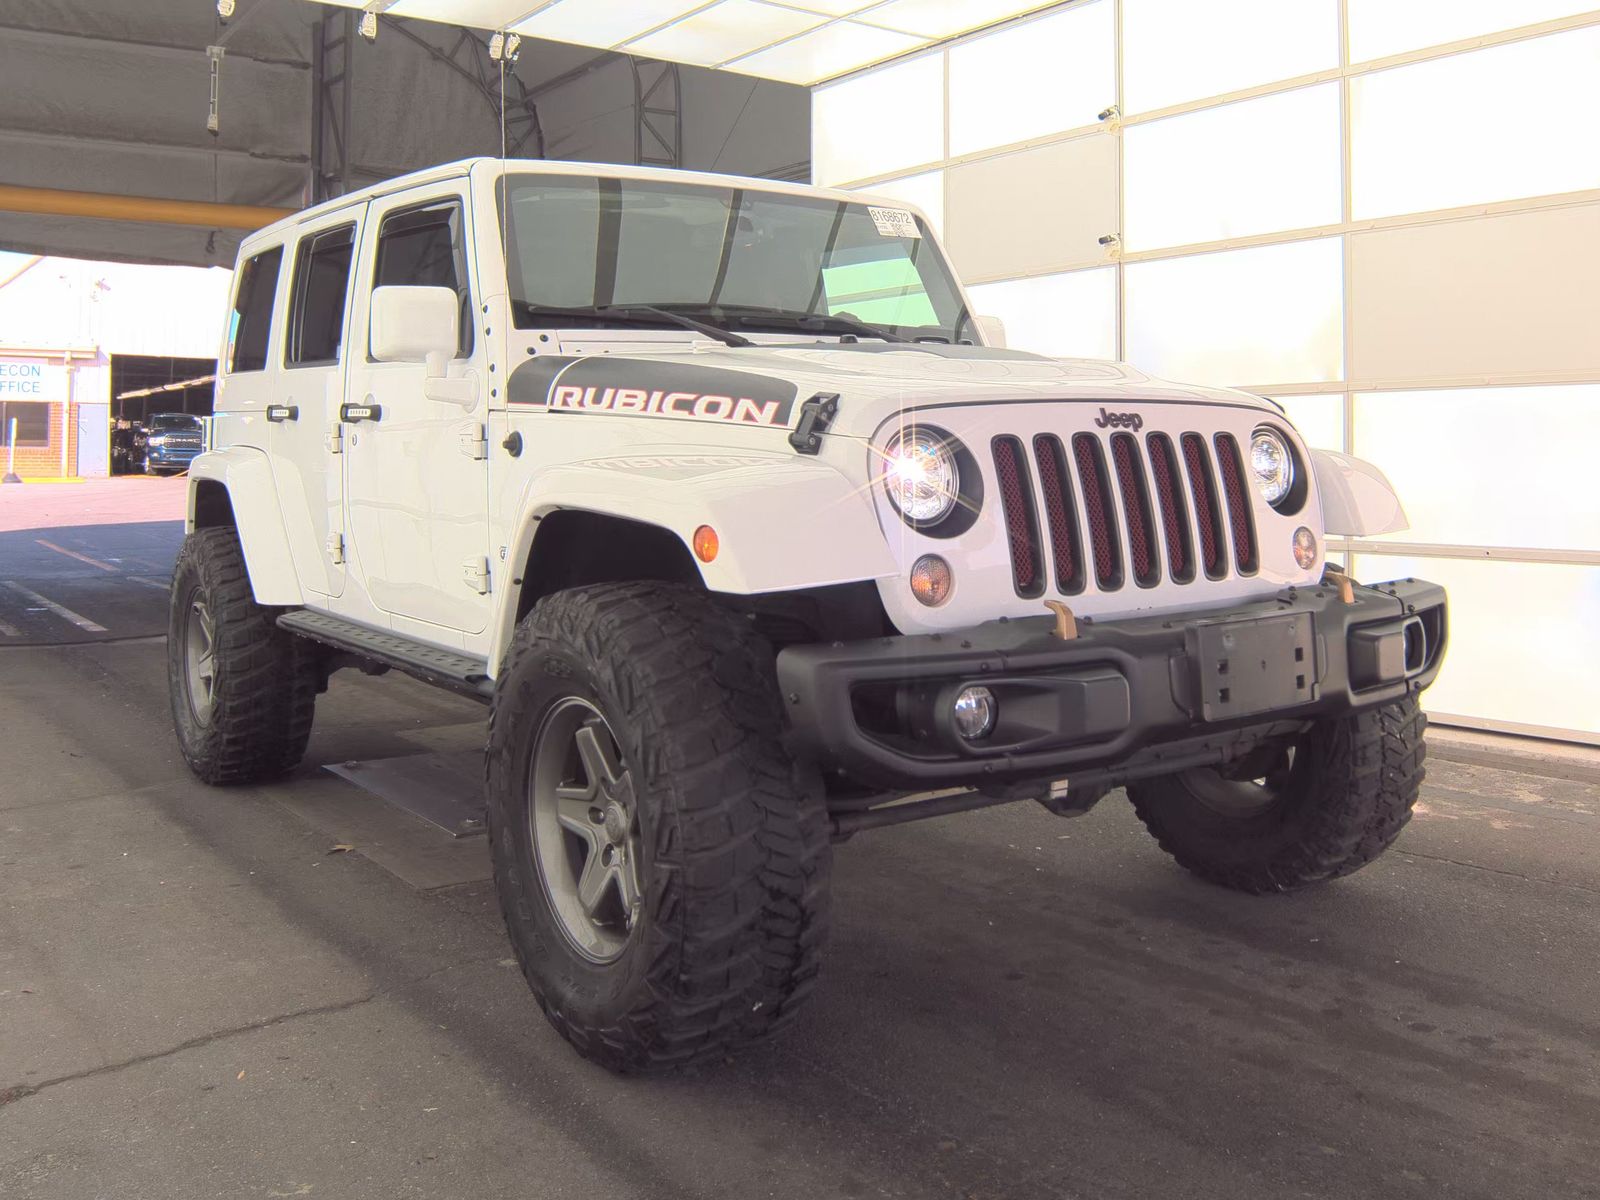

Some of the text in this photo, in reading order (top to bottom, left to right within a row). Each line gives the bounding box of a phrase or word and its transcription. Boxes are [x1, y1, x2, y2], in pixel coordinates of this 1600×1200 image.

[871, 209, 911, 224] 8168672
[554, 386, 779, 425] RUBICON
[1094, 407, 1144, 432] Jeep
